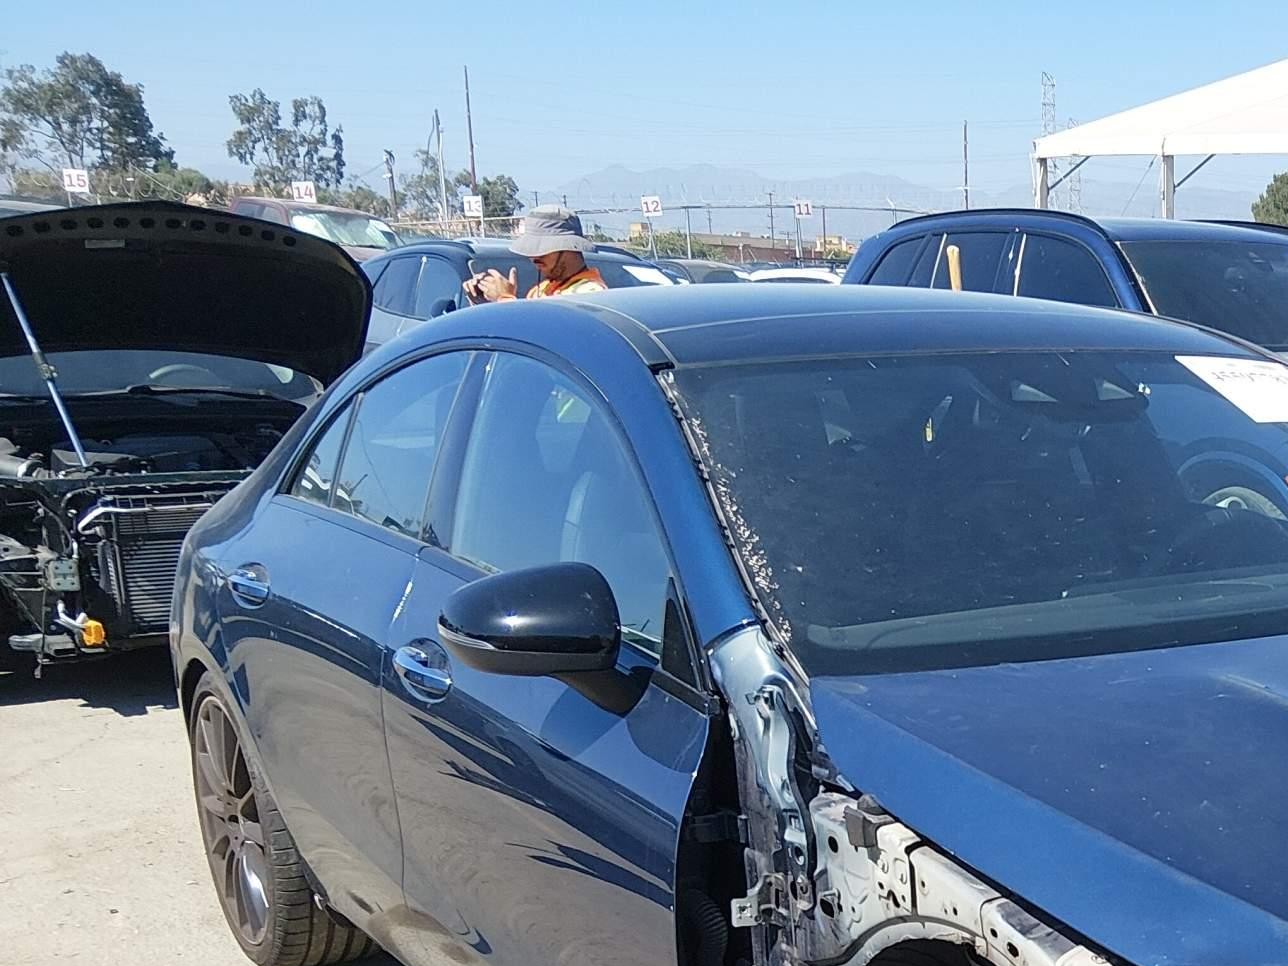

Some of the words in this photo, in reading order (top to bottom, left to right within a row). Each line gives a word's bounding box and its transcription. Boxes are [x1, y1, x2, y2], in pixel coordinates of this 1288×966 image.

[65, 174, 87, 187] 15
[294, 185, 313, 199] 14
[643, 200, 660, 213] 12
[796, 203, 811, 215] 11
